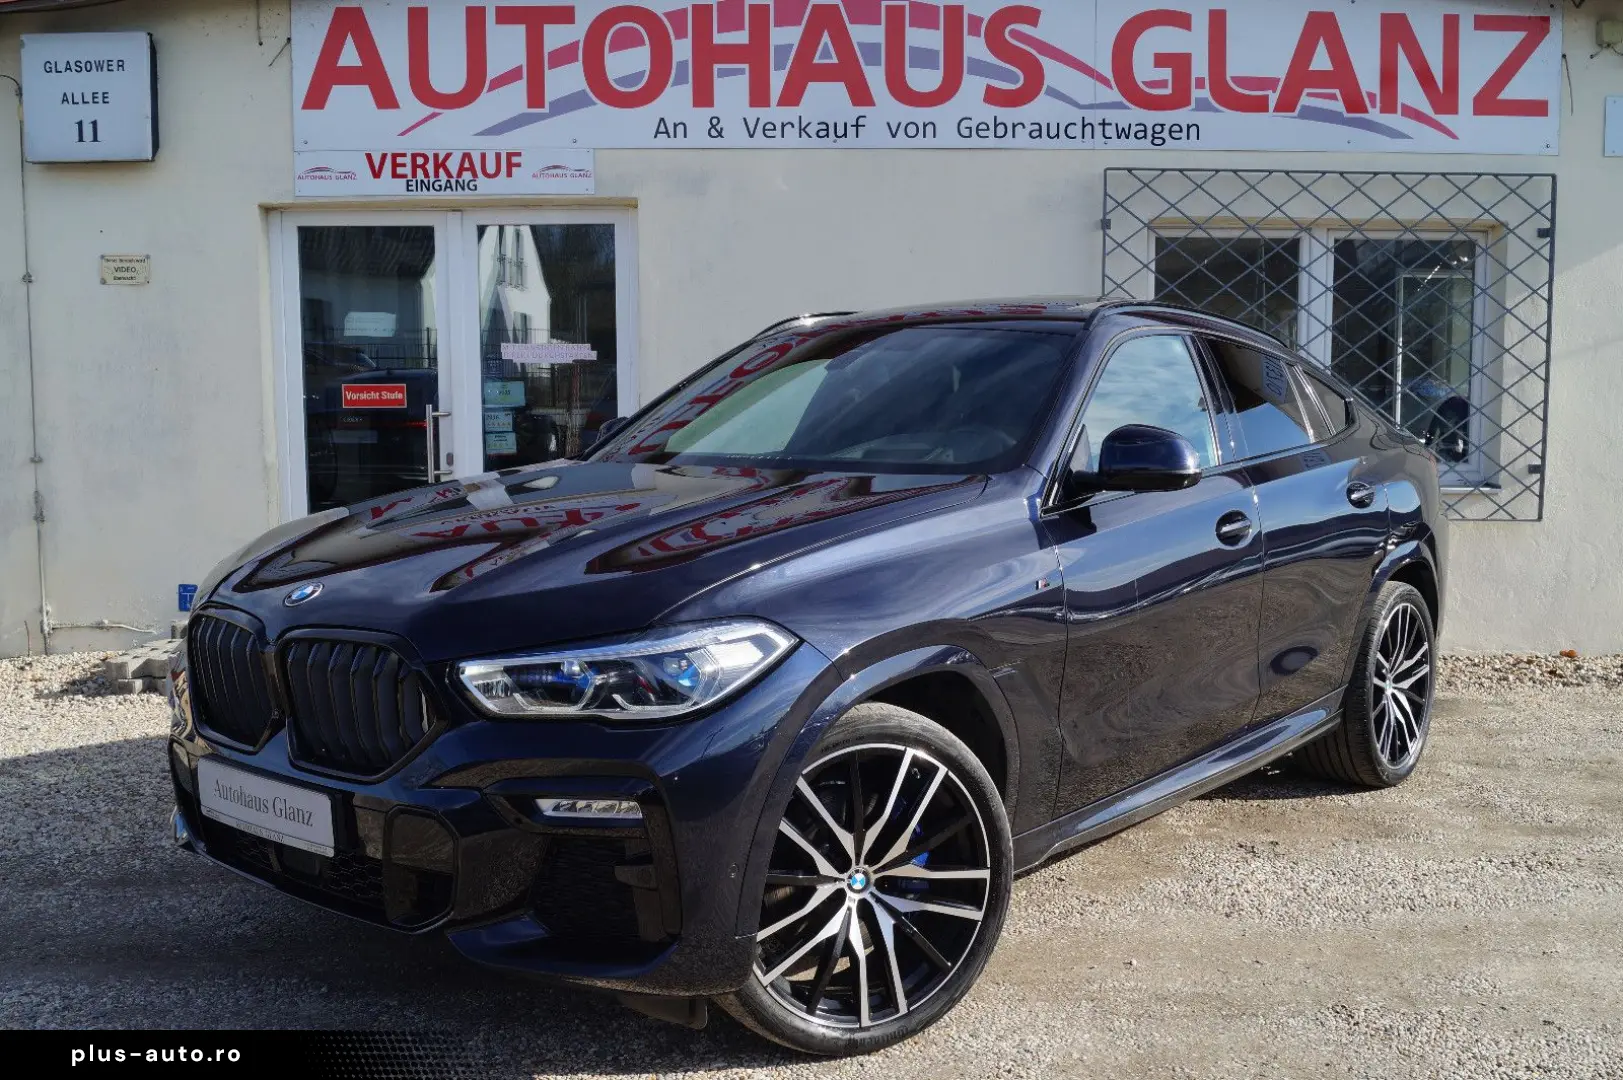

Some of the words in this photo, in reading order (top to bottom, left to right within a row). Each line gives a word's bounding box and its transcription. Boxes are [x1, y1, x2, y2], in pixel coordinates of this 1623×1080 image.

[43, 59, 126, 74] GLASOWER
[302, 3, 1045, 110] AUTOHAUS
[1110, 9, 1551, 117] GLANZ
[61, 91, 110, 105] ALLEE
[75, 119, 102, 143] 11
[653, 117, 688, 139] An
[706, 115, 725, 139] &
[742, 115, 867, 140] Verkauf
[886, 121, 937, 140] von
[957, 115, 1201, 147] Gebrauchtwagen
[365, 151, 522, 179] VERKAUF
[405, 179, 478, 193] EINGANG
[345, 391, 380, 401] Vorsicht
[381, 391, 403, 400] Stufe
[213, 778, 269, 815] Autohaus
[272, 796, 314, 828] Glanz
